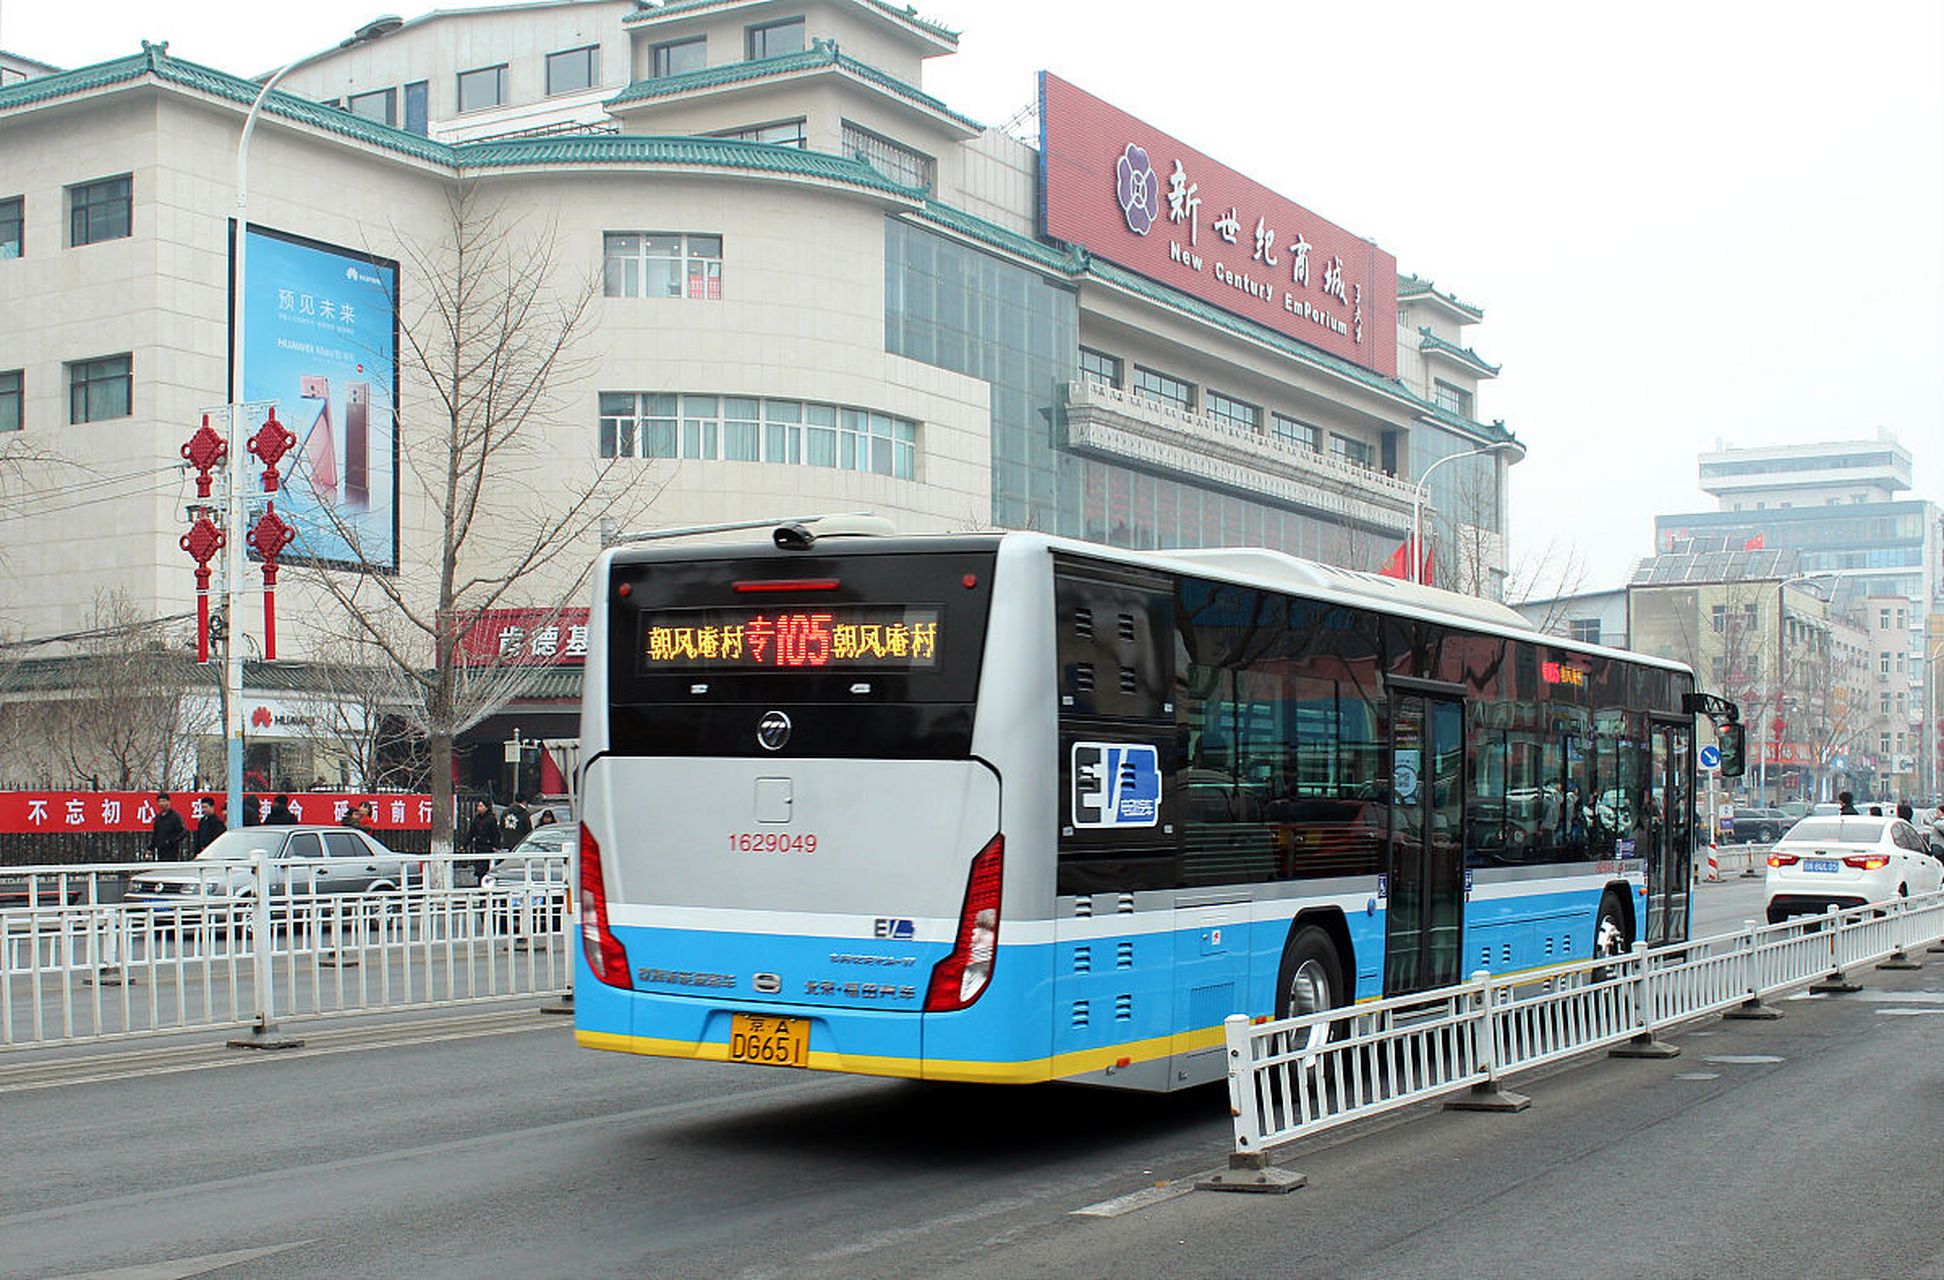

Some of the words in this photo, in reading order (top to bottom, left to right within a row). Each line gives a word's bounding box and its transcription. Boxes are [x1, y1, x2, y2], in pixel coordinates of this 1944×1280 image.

[1168, 159, 1348, 305] 新世纪商城
[1170, 240, 1203, 271] New
[278, 289, 356, 325] 预见未来
[499, 625, 589, 657] 肯德基
[28, 800, 156, 825] 不忘初心
[191, 798, 304, 823] 牢使命
[729, 833, 817, 853] 1629049
[733, 1034, 800, 1063] DG651
